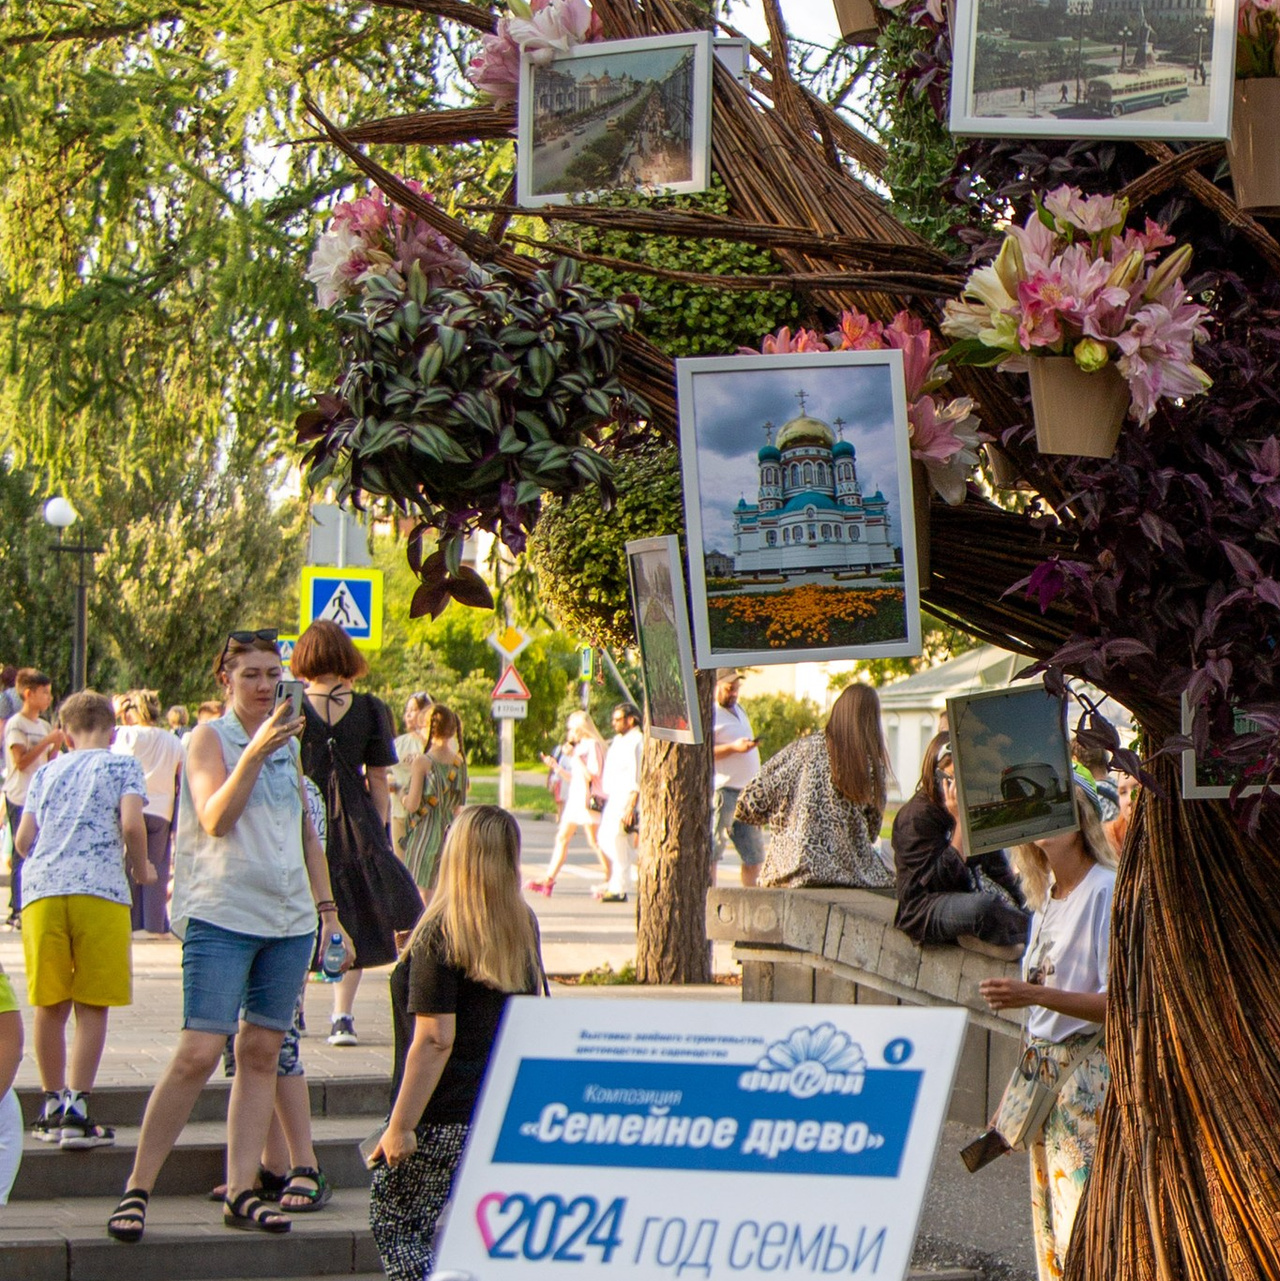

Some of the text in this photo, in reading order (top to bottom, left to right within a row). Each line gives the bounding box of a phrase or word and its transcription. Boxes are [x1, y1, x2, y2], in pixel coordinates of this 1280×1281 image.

[891, 1042, 905, 1061] 1
[582, 1084, 683, 1106] Композиция
[519, 1102, 885, 1159] «Семейное древо»
[487, 1191, 629, 1264] 2024
